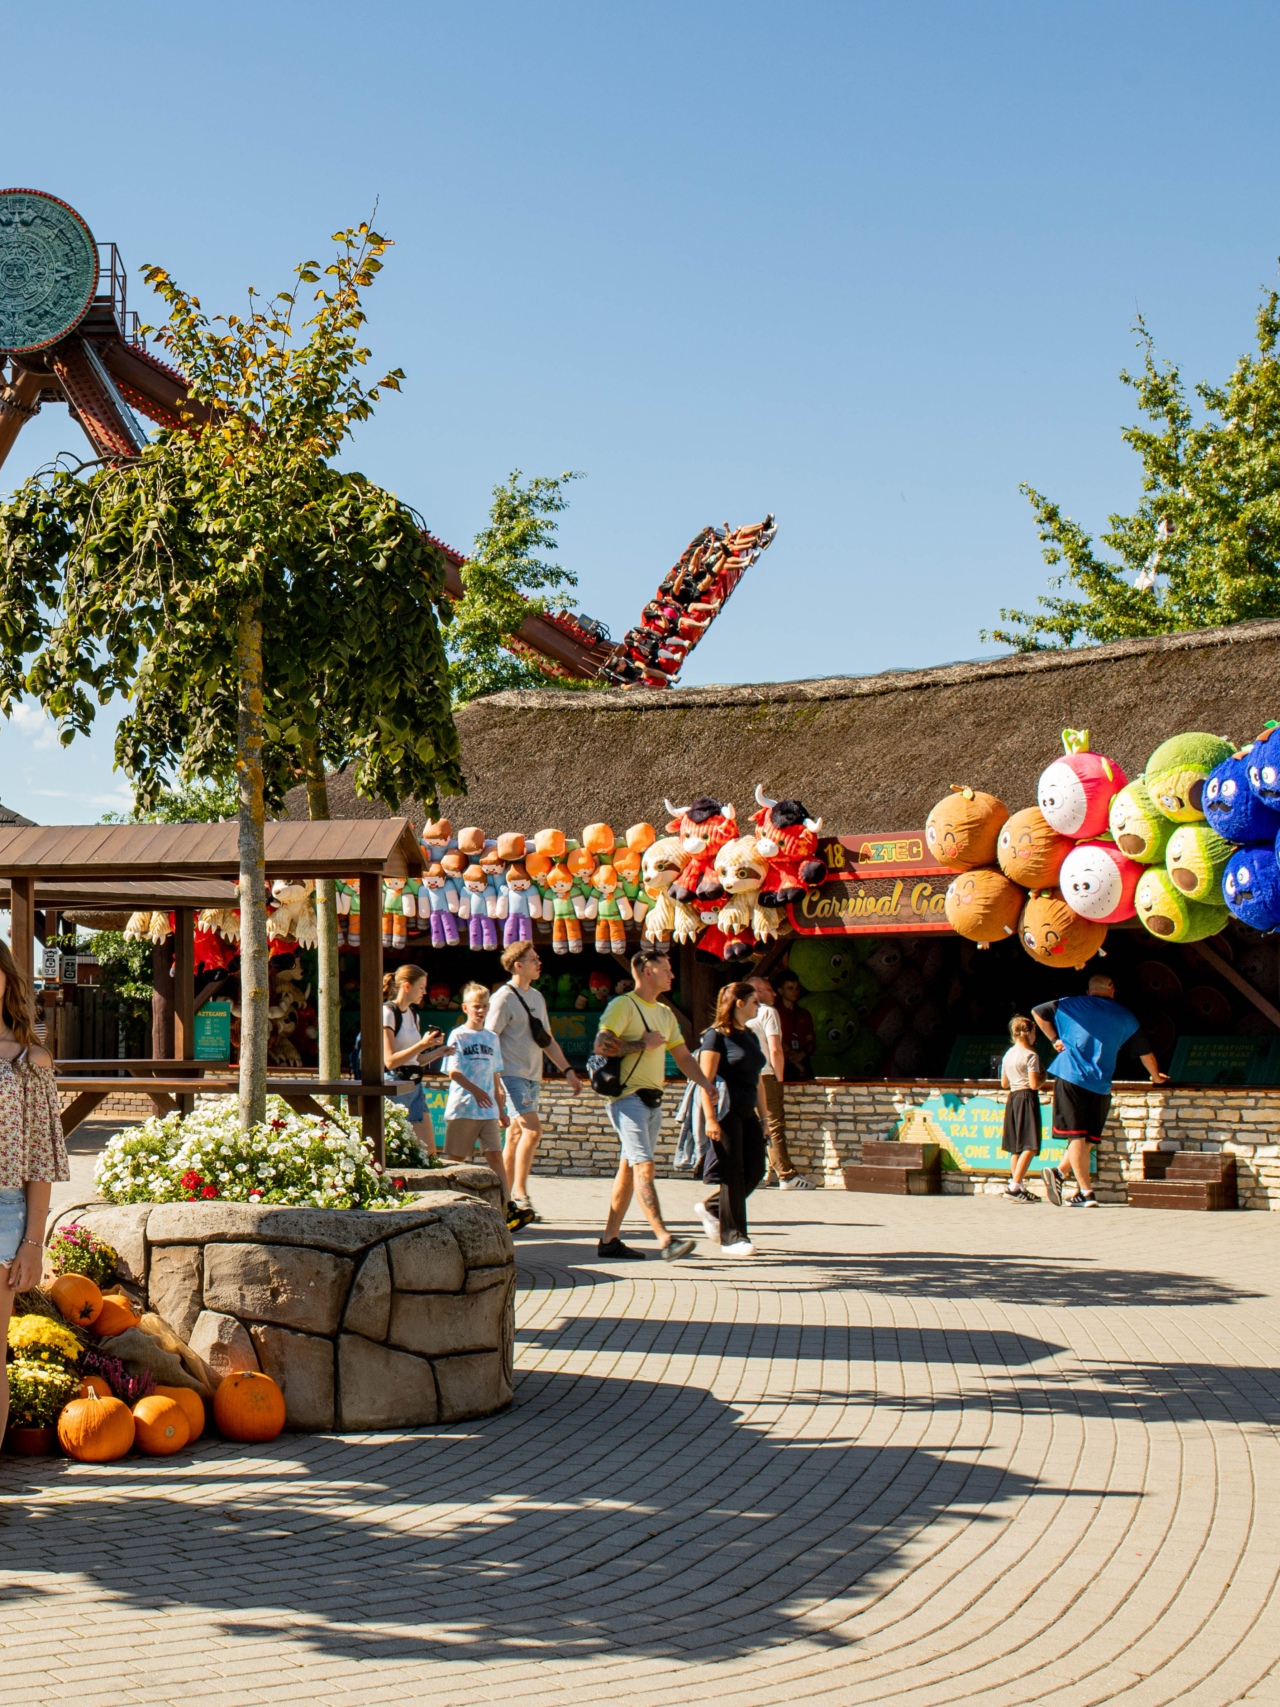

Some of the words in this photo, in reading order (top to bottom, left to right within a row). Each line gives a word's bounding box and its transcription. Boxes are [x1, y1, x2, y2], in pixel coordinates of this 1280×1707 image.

[823, 843, 844, 868] 18
[858, 839, 923, 864] AZTEC
[801, 880, 904, 919] Carnival
[938, 1108, 965, 1121] RAZ
[971, 1108, 1006, 1122] TRAF
[950, 1124, 977, 1138] RAZ
[964, 1145, 990, 1159] ONE
